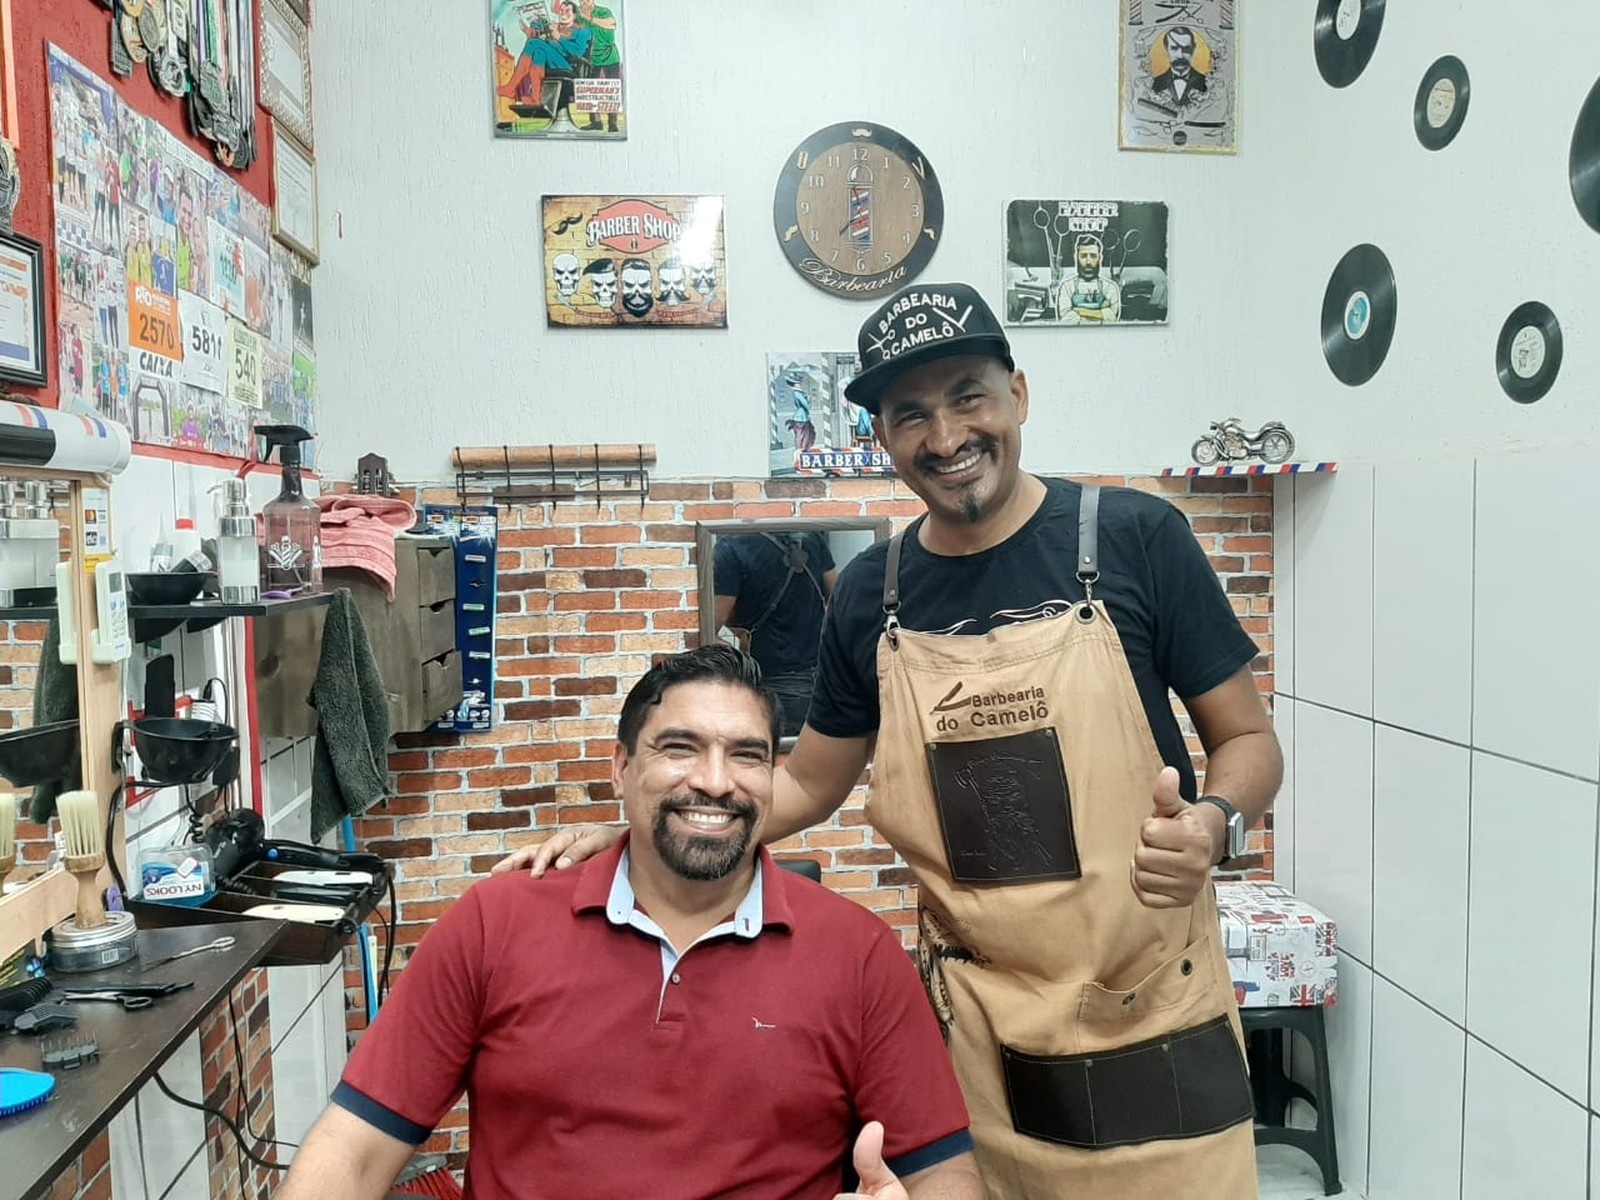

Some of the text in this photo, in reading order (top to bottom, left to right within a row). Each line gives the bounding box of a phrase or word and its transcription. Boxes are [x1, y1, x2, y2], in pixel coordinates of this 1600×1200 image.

[852, 148, 869, 161] 12
[828, 155, 840, 168] 11
[883, 156, 890, 169] 1
[809, 175, 824, 188] 10
[902, 176, 911, 189] 2
[801, 202, 810, 214] 9
[911, 204, 920, 217] 3
[810, 229, 819, 242] 8
[902, 231, 911, 244] 4
[831, 250, 839, 262] 7
[884, 251, 892, 264] 5
[856, 258, 865, 270] 6
[799, 257, 908, 293] Barbearia
[878, 292, 957, 335] BARBEARIA
[904, 313, 927, 329] DO
[139, 312, 175, 351] 2570
[891, 320, 954, 356] CAMELÔ
[139, 351, 173, 378] CAIXA
[234, 347, 256, 387] 540
[801, 453, 892, 468] BARBER SH
[971, 685, 1045, 708] Barbearia
[936, 702, 1049, 732] do Camelô
